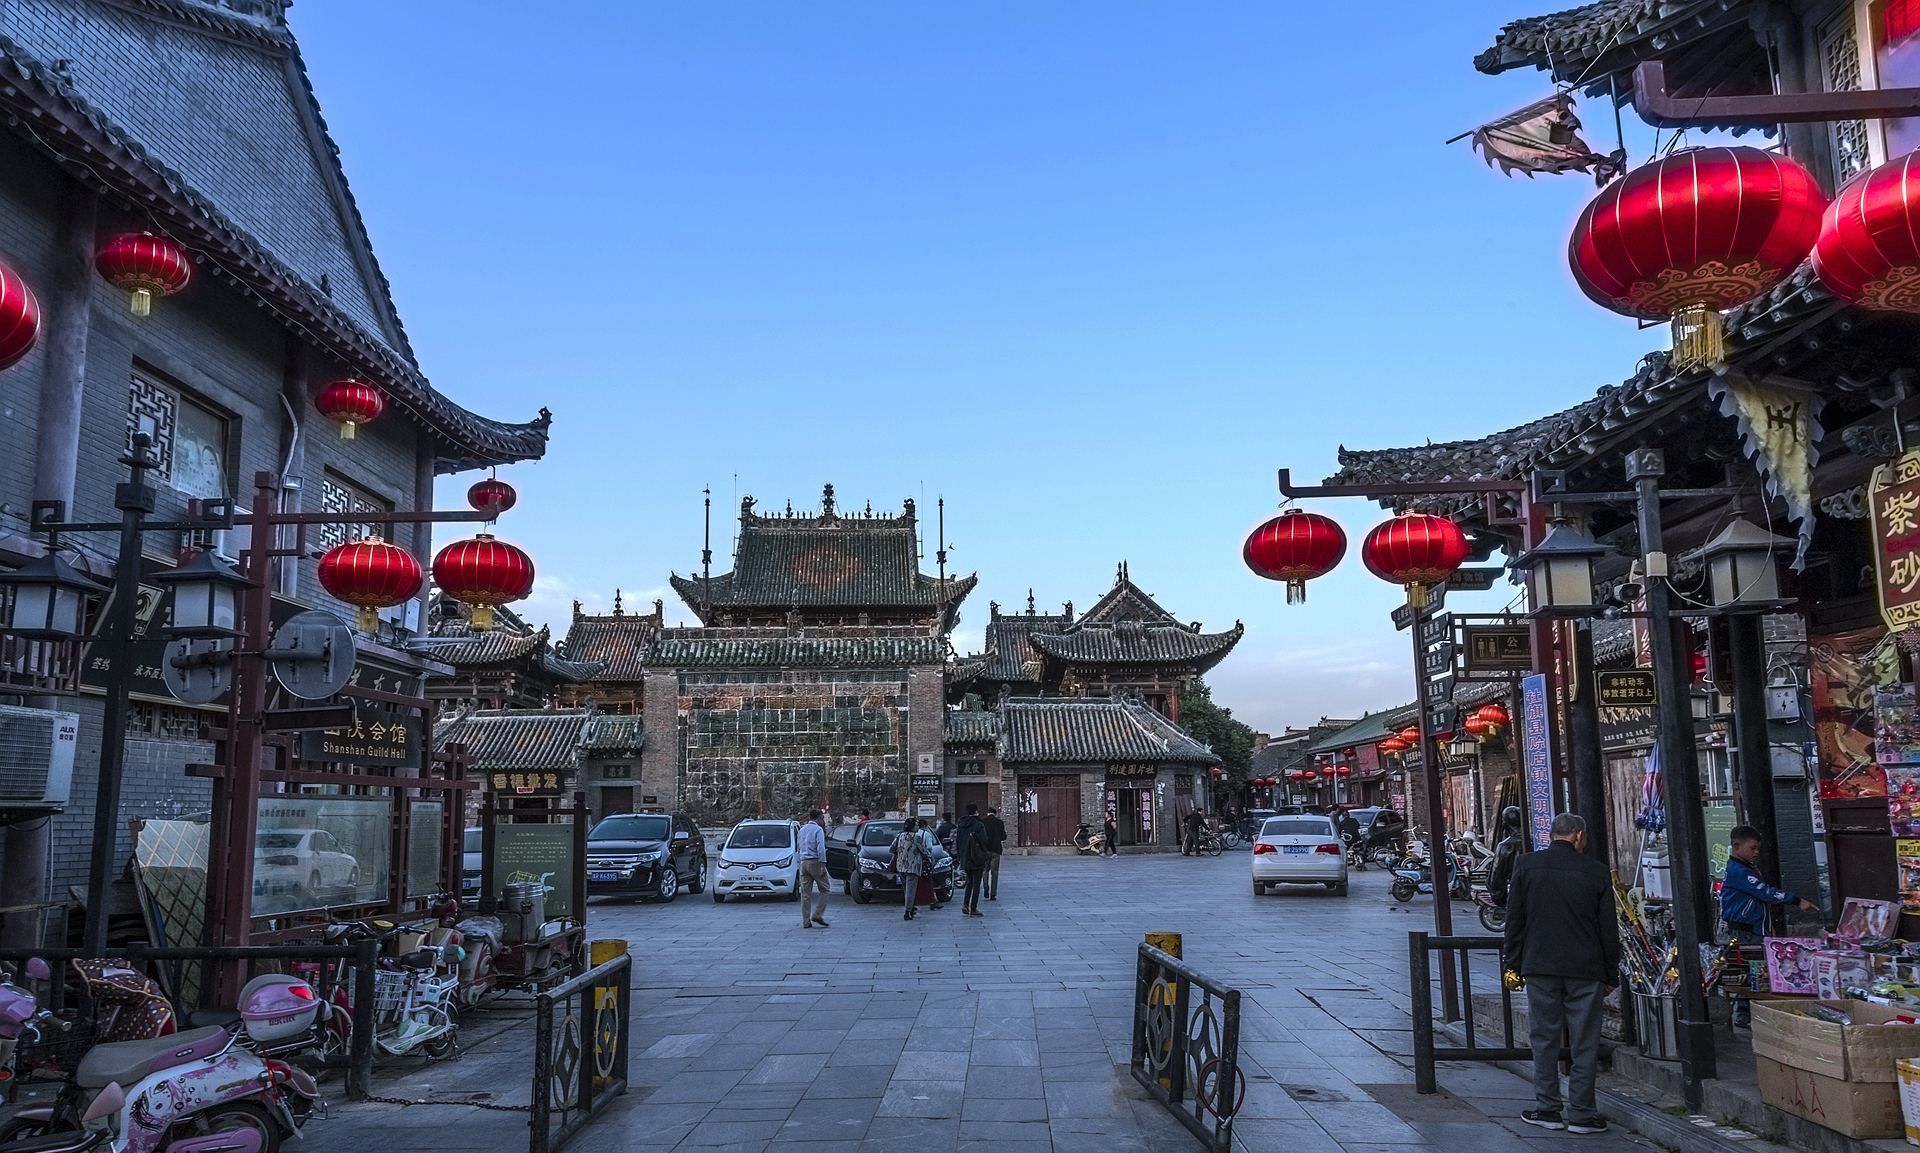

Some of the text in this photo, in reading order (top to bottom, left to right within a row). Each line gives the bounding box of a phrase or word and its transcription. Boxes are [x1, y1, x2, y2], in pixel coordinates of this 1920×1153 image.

[1881, 490, 1920, 594] 紫砂
[60, 725, 75, 734] AUX
[323, 741, 406, 759] Shanshan Guild Hall
[1525, 688, 1551, 851] 社旗县赊店镇文明诚信
